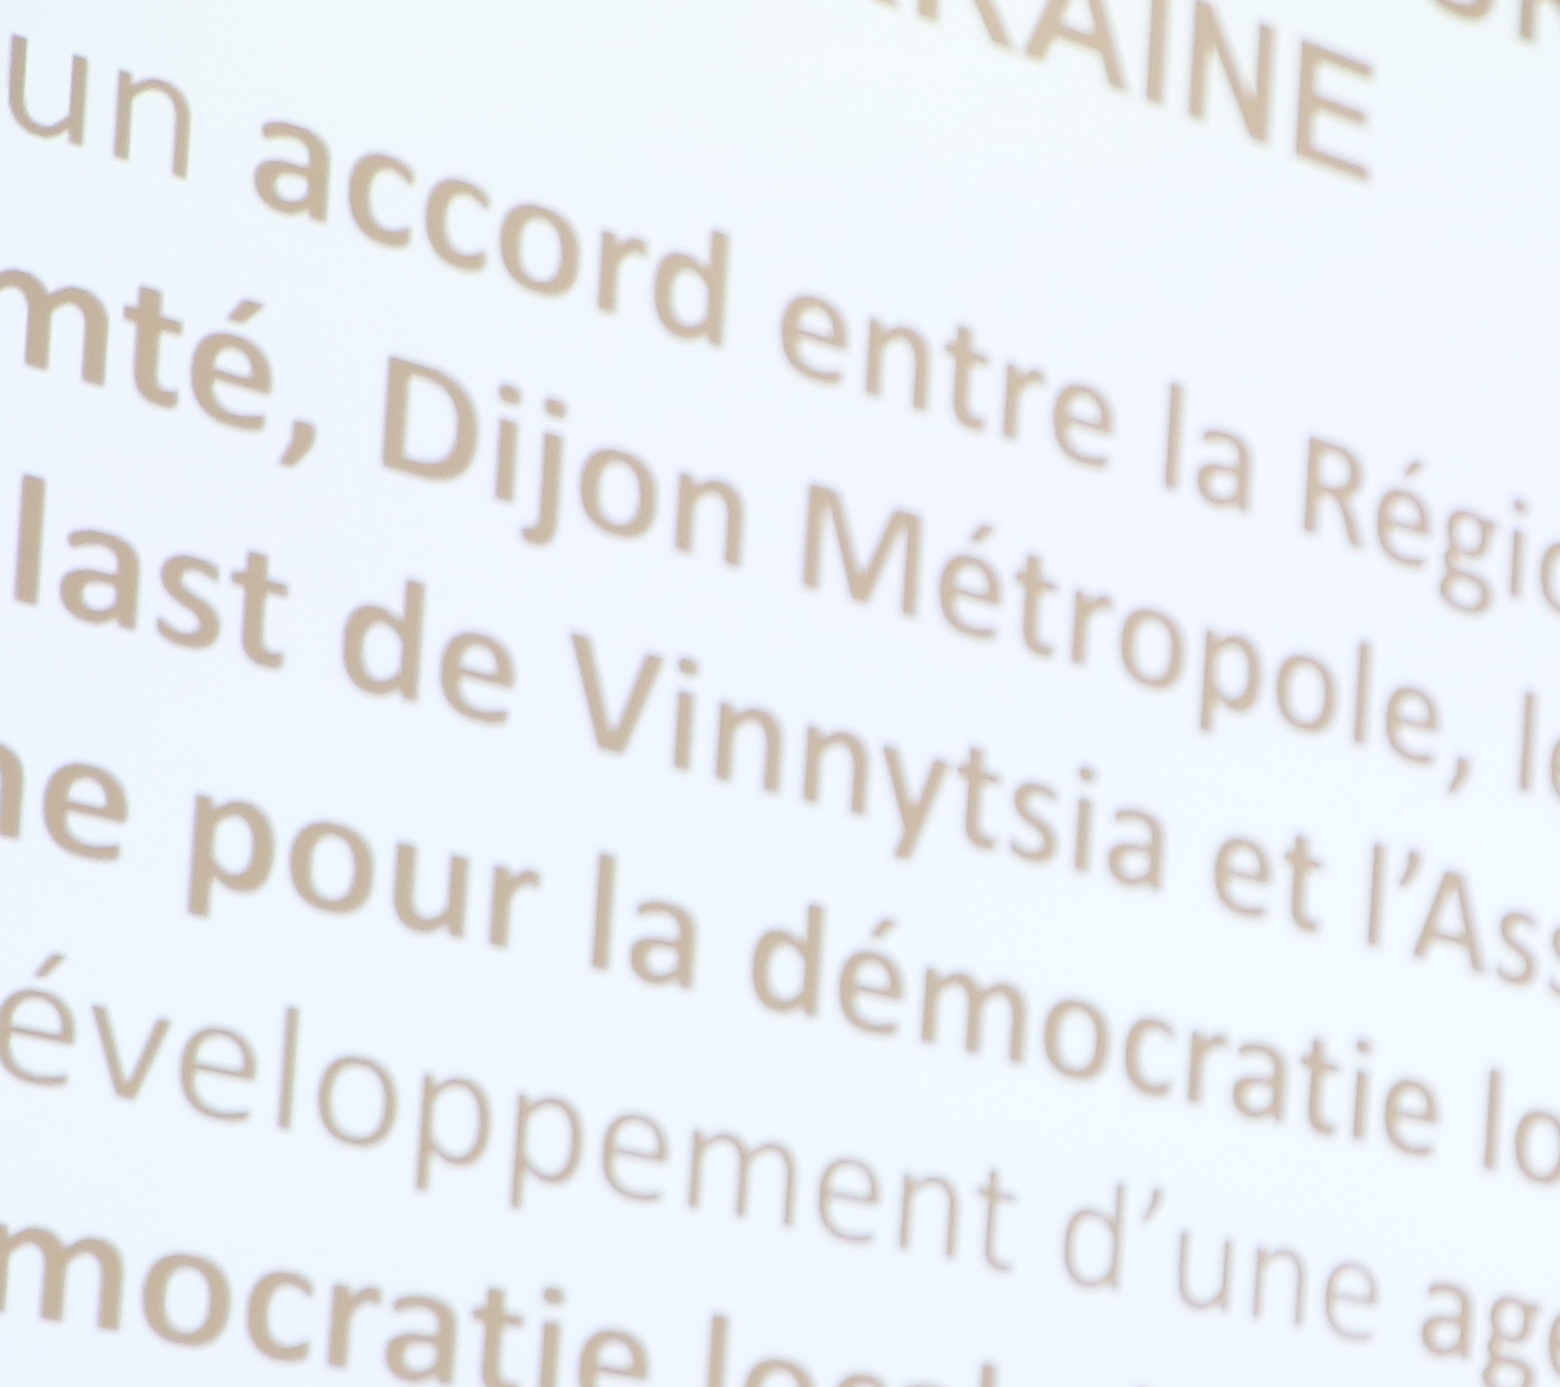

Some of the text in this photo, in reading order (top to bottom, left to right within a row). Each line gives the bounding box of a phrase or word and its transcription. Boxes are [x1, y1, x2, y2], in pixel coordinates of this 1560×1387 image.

[6, 32, 192, 181] un
[251, 116, 731, 349] accord
[779, 289, 1116, 469] entre
[1161, 380, 1254, 515] la
[8, 473, 290, 674] last
[341, 578, 517, 726] de
[570, 630, 1168, 892] Vinnytsia
[1211, 832, 1326, 934] et
[379, 353, 746, 570] Dijon
[802, 481, 1472, 796] Métropole,
[0, 951, 1018, 1278] éveloppement
[1061, 1178, 1382, 1342] d’une
[187, 789, 542, 949] pour
[590, 850, 700, 990] la
[749, 901, 1443, 1157] démocratie
